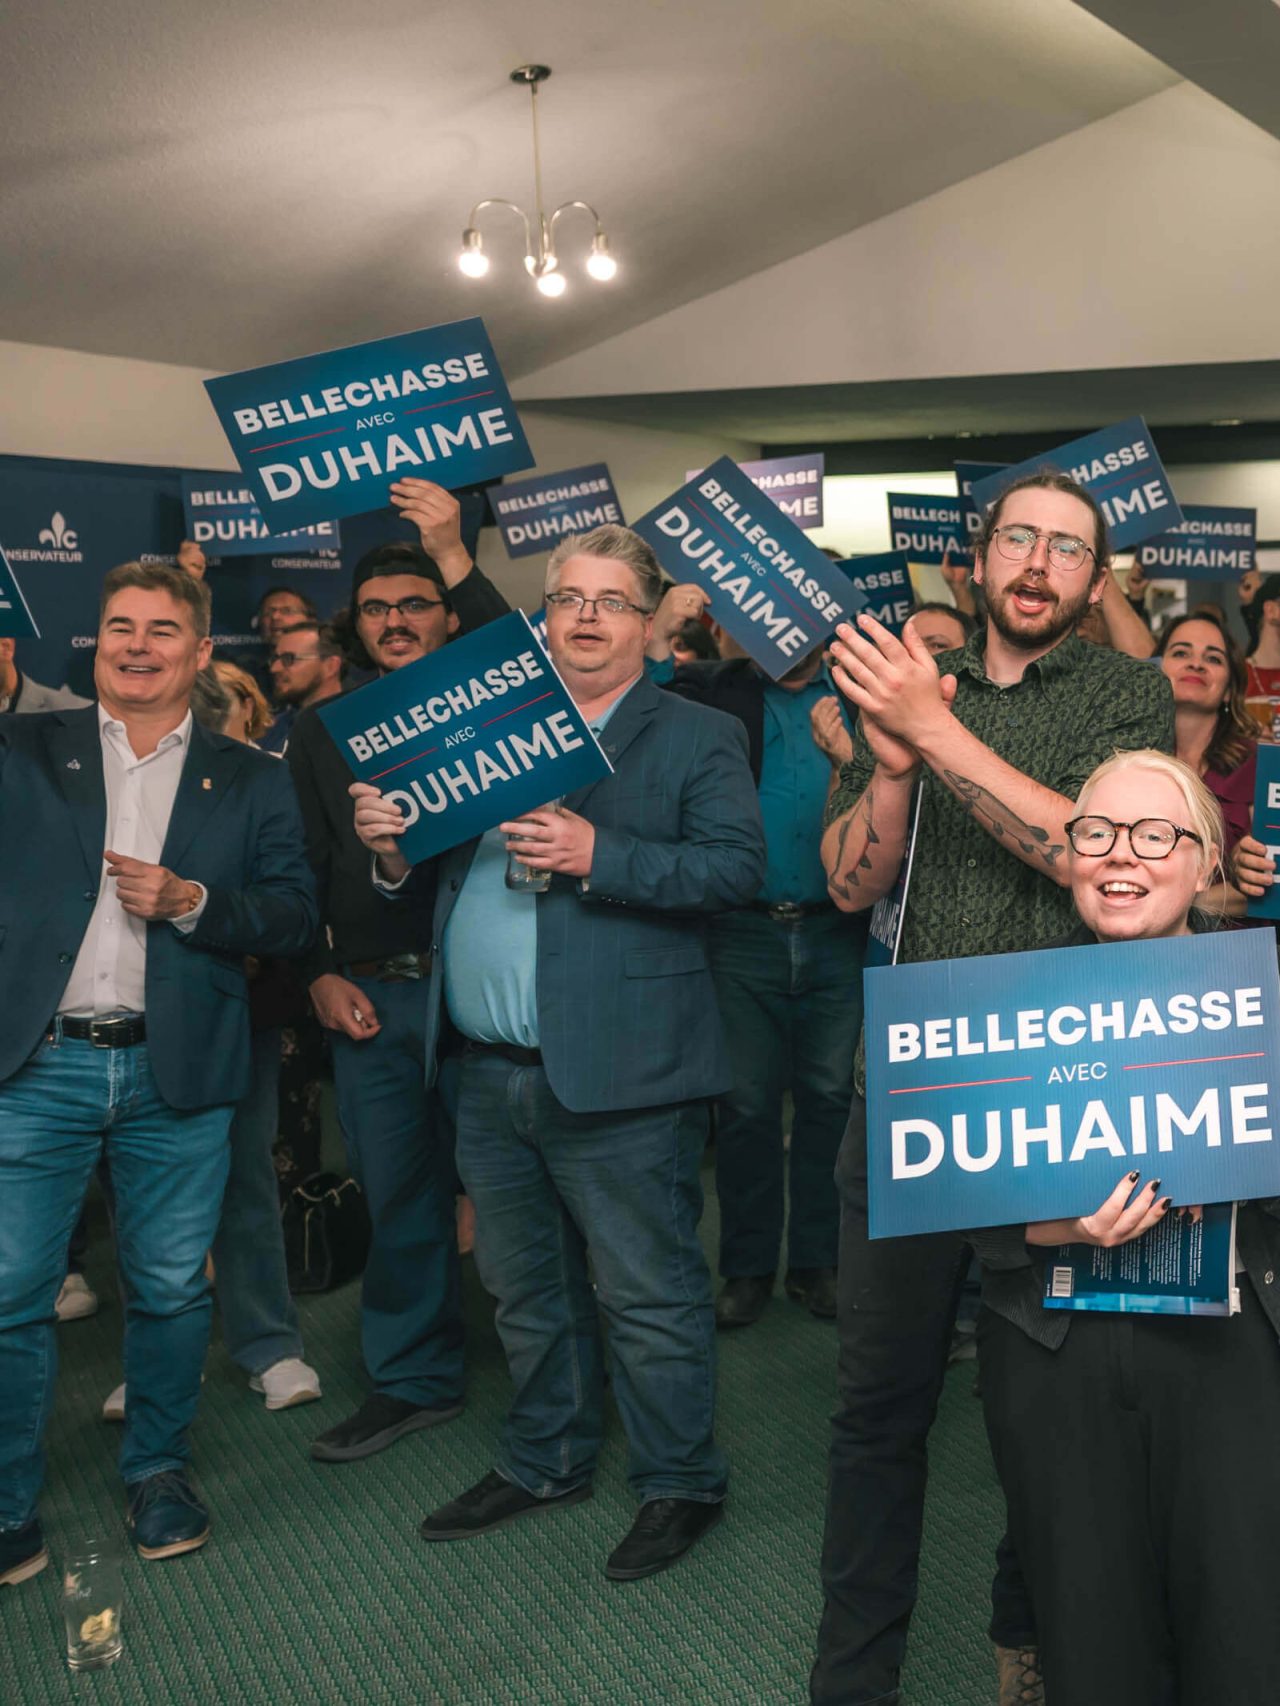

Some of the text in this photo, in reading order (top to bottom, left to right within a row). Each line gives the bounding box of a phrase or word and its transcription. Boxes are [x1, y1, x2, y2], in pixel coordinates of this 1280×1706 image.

[233, 352, 490, 435] BELLECHASSE
[355, 411, 395, 431] AVEC
[259, 407, 514, 501] DUHAIME
[498, 478, 609, 514] BELLECHASSE
[194, 519, 333, 542] DUHE
[507, 503, 619, 545] DUHAIME
[893, 506, 961, 523] BELLECH
[6, 549, 83, 563] NSERVATEUR
[698, 478, 843, 623] BELLECHASSE
[895, 531, 967, 554] DUHA
[1142, 546, 1251, 569] DUHAIME
[655, 505, 809, 657] DUHAIME
[740, 552, 767, 576] AVEC
[347, 650, 545, 763] BELLECHASSE
[444, 726, 476, 749] AVEC
[382, 709, 585, 829] DUHAIME
[888, 987, 1264, 1063] BELLECHASSE
[1047, 1062, 1108, 1084] AVEC
[891, 1083, 1273, 1180] DUHAIME
